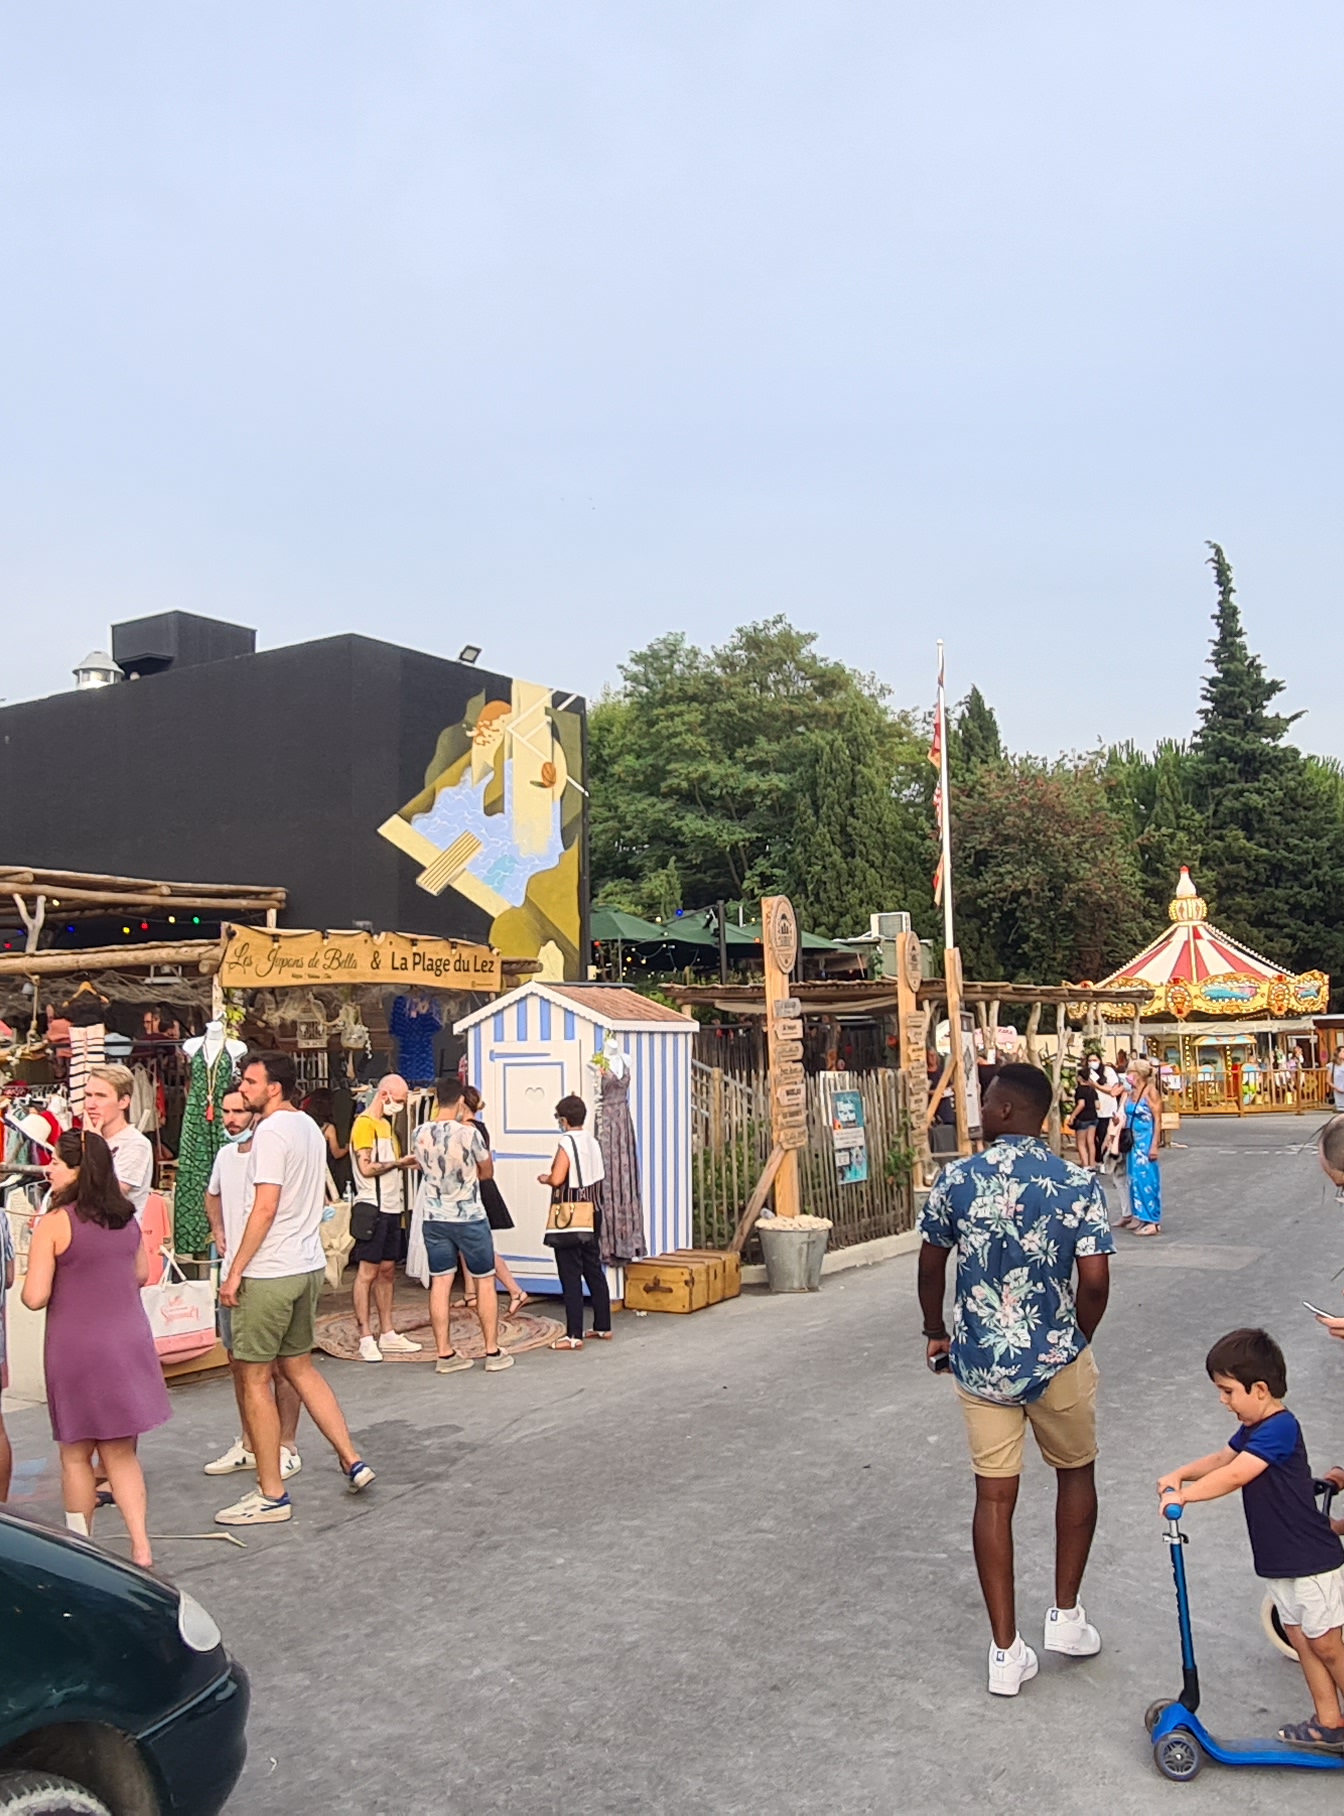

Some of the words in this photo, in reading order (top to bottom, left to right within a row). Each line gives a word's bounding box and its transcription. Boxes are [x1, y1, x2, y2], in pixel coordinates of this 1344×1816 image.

[308, 951, 321, 969] de
[370, 950, 382, 970] &
[391, 951, 408, 971] La
[412, 951, 451, 977] Plage
[453, 953, 470, 972] du
[473, 954, 495, 973] Lez
